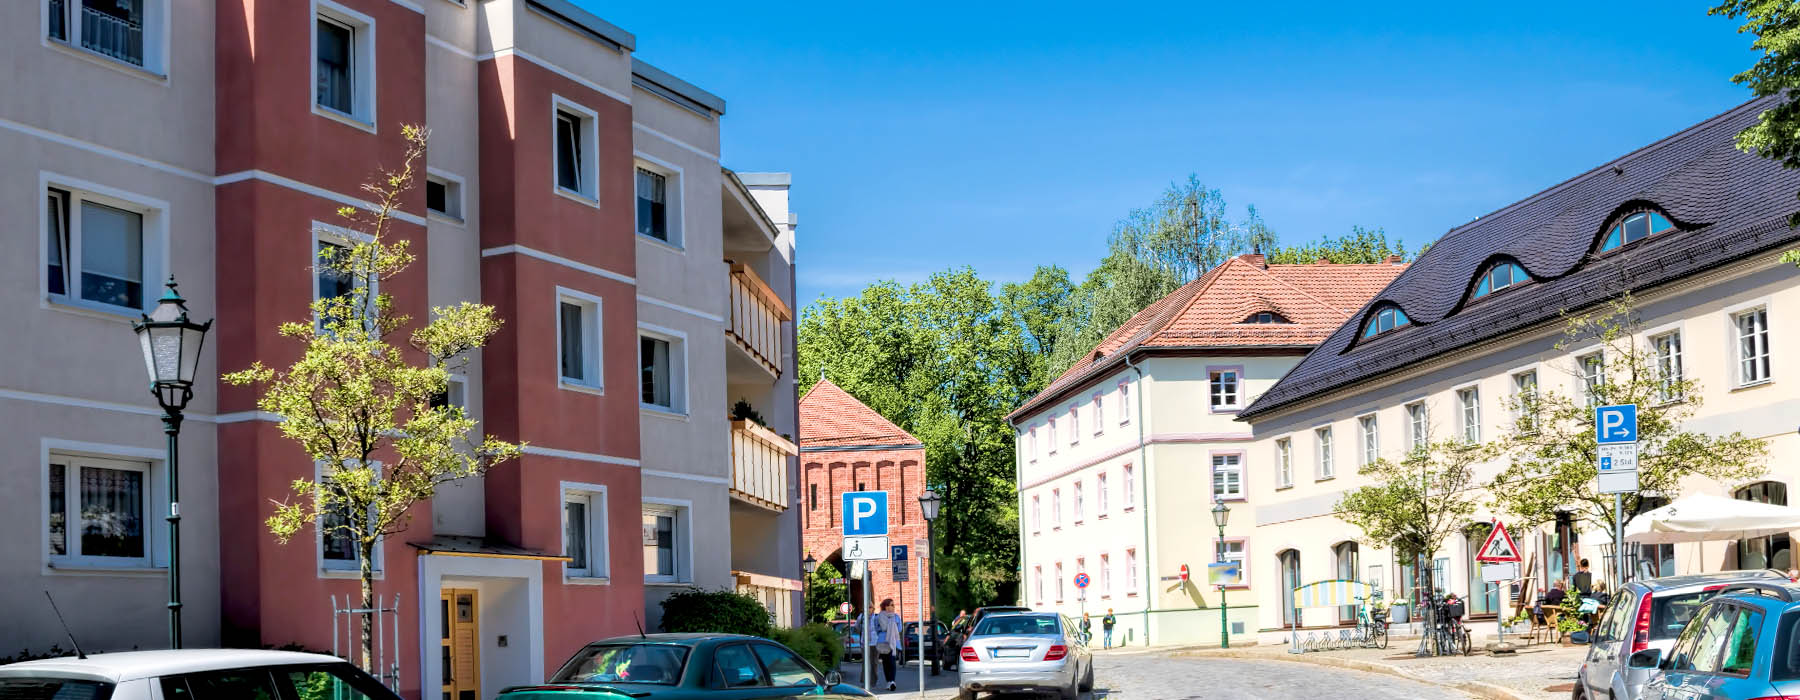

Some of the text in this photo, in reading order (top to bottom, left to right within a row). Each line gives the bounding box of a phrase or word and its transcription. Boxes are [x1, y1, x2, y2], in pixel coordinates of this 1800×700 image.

[1603, 411, 1624, 439] P
[853, 498, 877, 531] P
[894, 547, 903, 560] P
